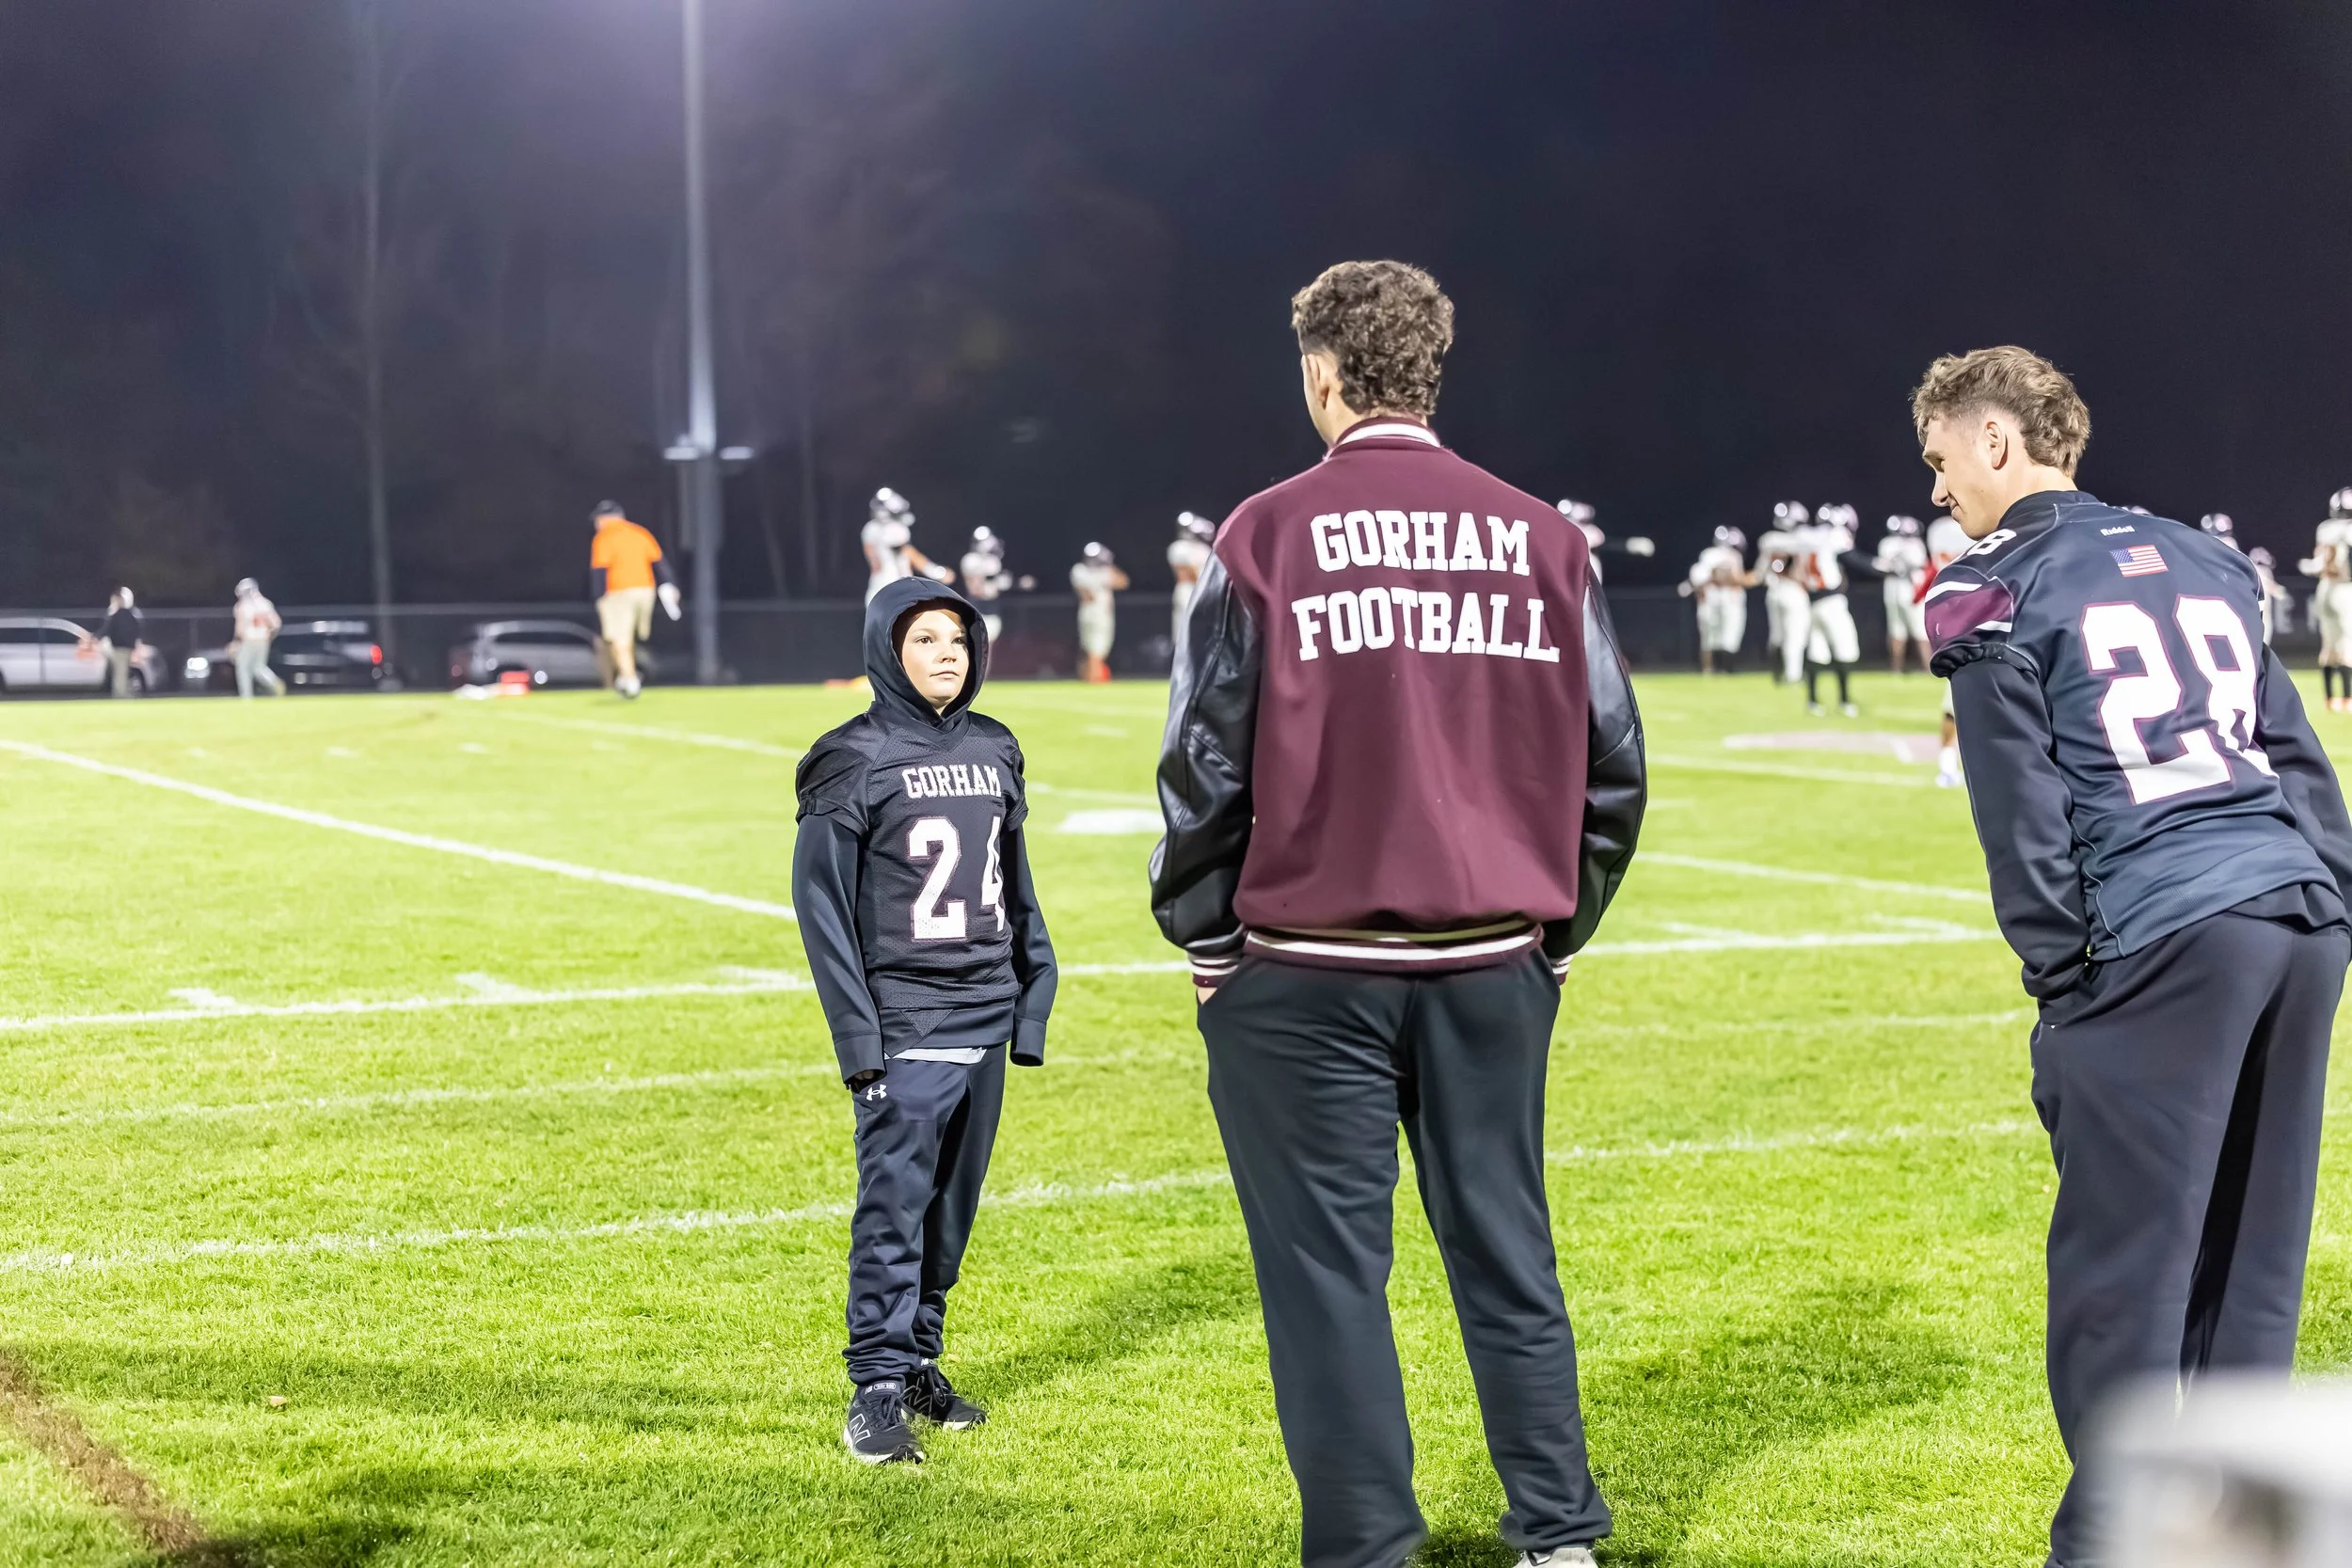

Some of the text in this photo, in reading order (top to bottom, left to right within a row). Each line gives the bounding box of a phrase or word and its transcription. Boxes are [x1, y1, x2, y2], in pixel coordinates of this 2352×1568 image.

[1310, 509, 1531, 577] GORHAM
[2100, 525, 2136, 536] Riddell
[1291, 586, 1561, 661] FOOTBALL
[2079, 593, 2280, 806] 28
[901, 764, 1002, 800] GORHAM
[906, 815, 1007, 942] 24
